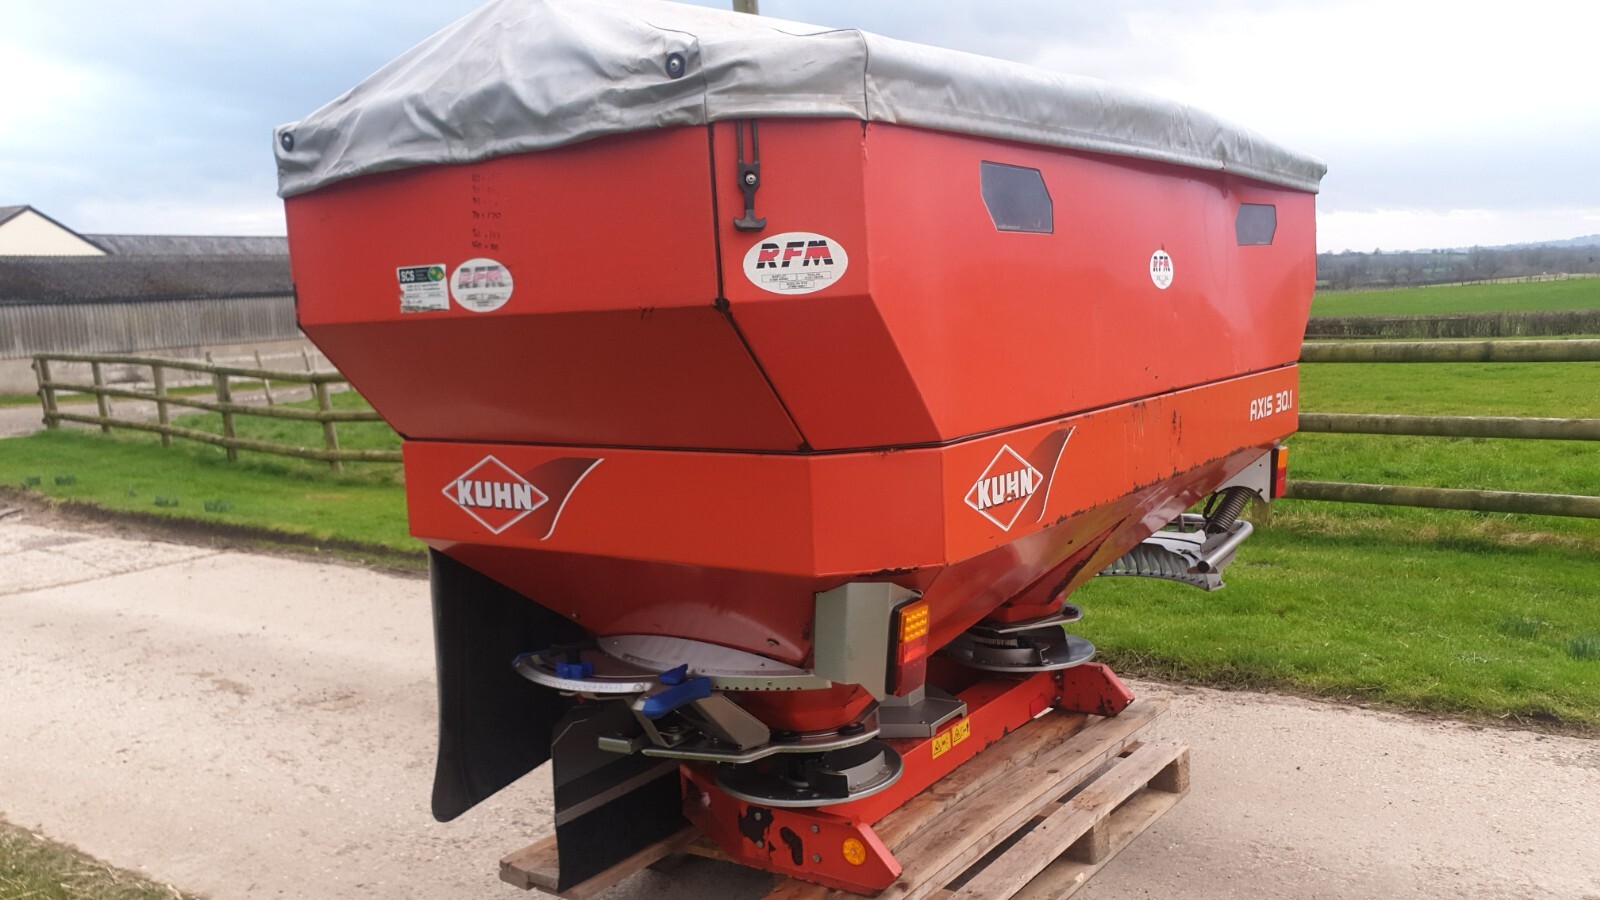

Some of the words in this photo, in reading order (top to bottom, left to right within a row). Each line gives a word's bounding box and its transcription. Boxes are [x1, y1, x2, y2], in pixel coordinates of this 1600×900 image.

[756, 240, 834, 269] RFM
[1153, 255, 1171, 272] RFM
[400, 270, 415, 282] SCS
[1250, 394, 1273, 421] AXIS
[1275, 388, 1293, 413] 30.1
[457, 479, 533, 511] KUHN
[977, 467, 1033, 511] KUHN
